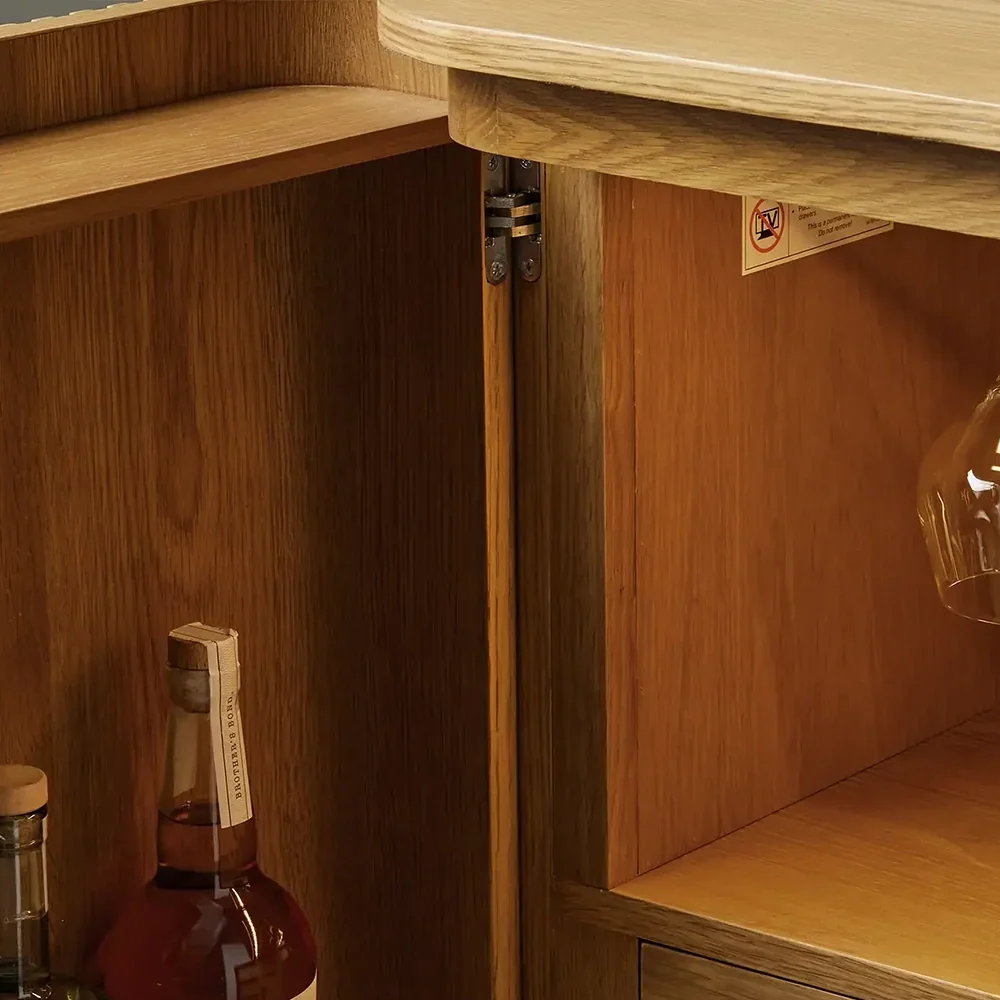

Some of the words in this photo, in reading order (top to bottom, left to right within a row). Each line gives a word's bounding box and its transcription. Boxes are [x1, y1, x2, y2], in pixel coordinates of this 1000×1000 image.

[818, 229, 826, 237] Do
[826, 226, 834, 234] not
[229, 732, 243, 800] BROTHER'S
